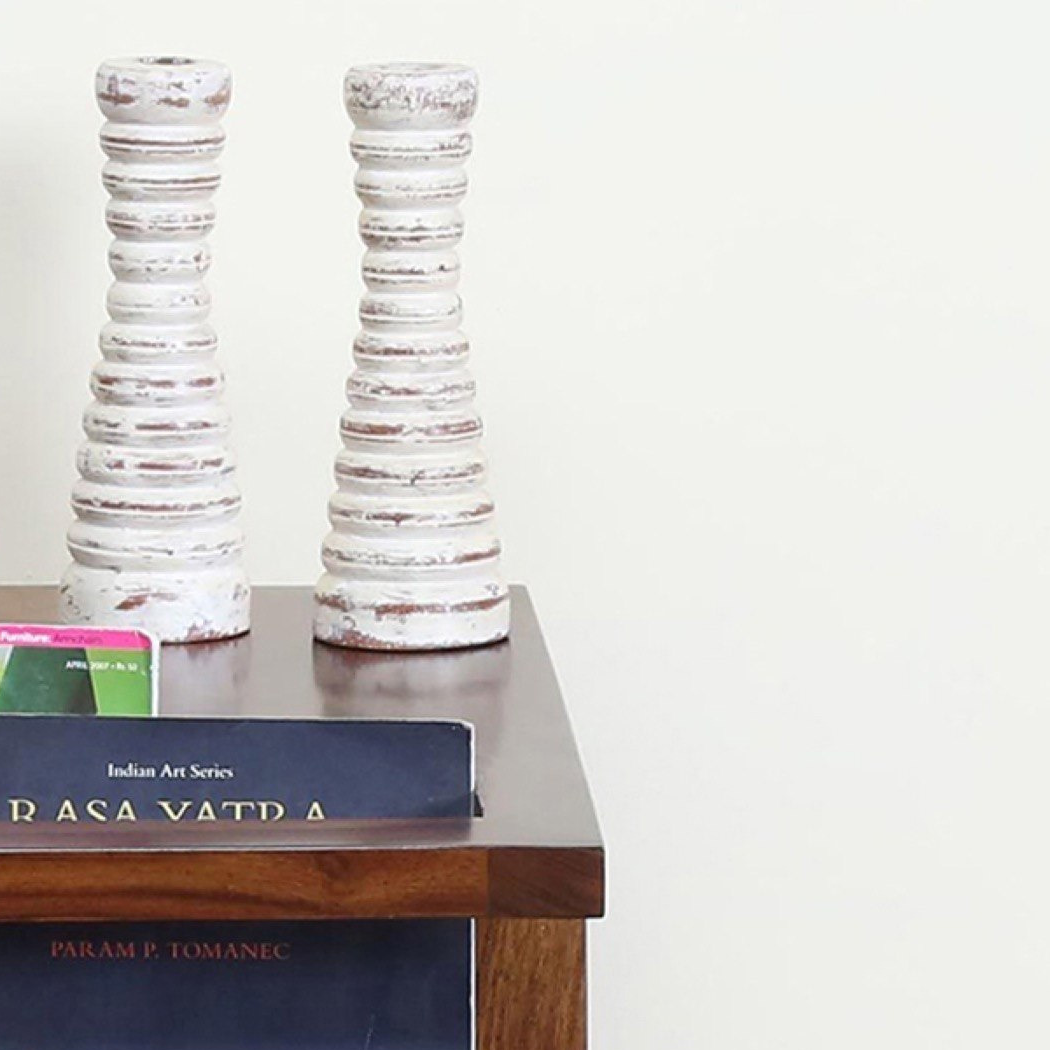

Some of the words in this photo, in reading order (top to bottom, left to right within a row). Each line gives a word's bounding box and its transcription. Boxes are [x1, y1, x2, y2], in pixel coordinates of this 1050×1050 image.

[65, 660, 87, 671] APRIL
[107, 762, 155, 779] Indian
[160, 762, 186, 779] Art
[189, 764, 234, 780] Series
[7, 799, 137, 822] RASA
[51, 940, 136, 960] PARAM
[144, 941, 159, 960] P.
[169, 941, 292, 961] TOMANEC
